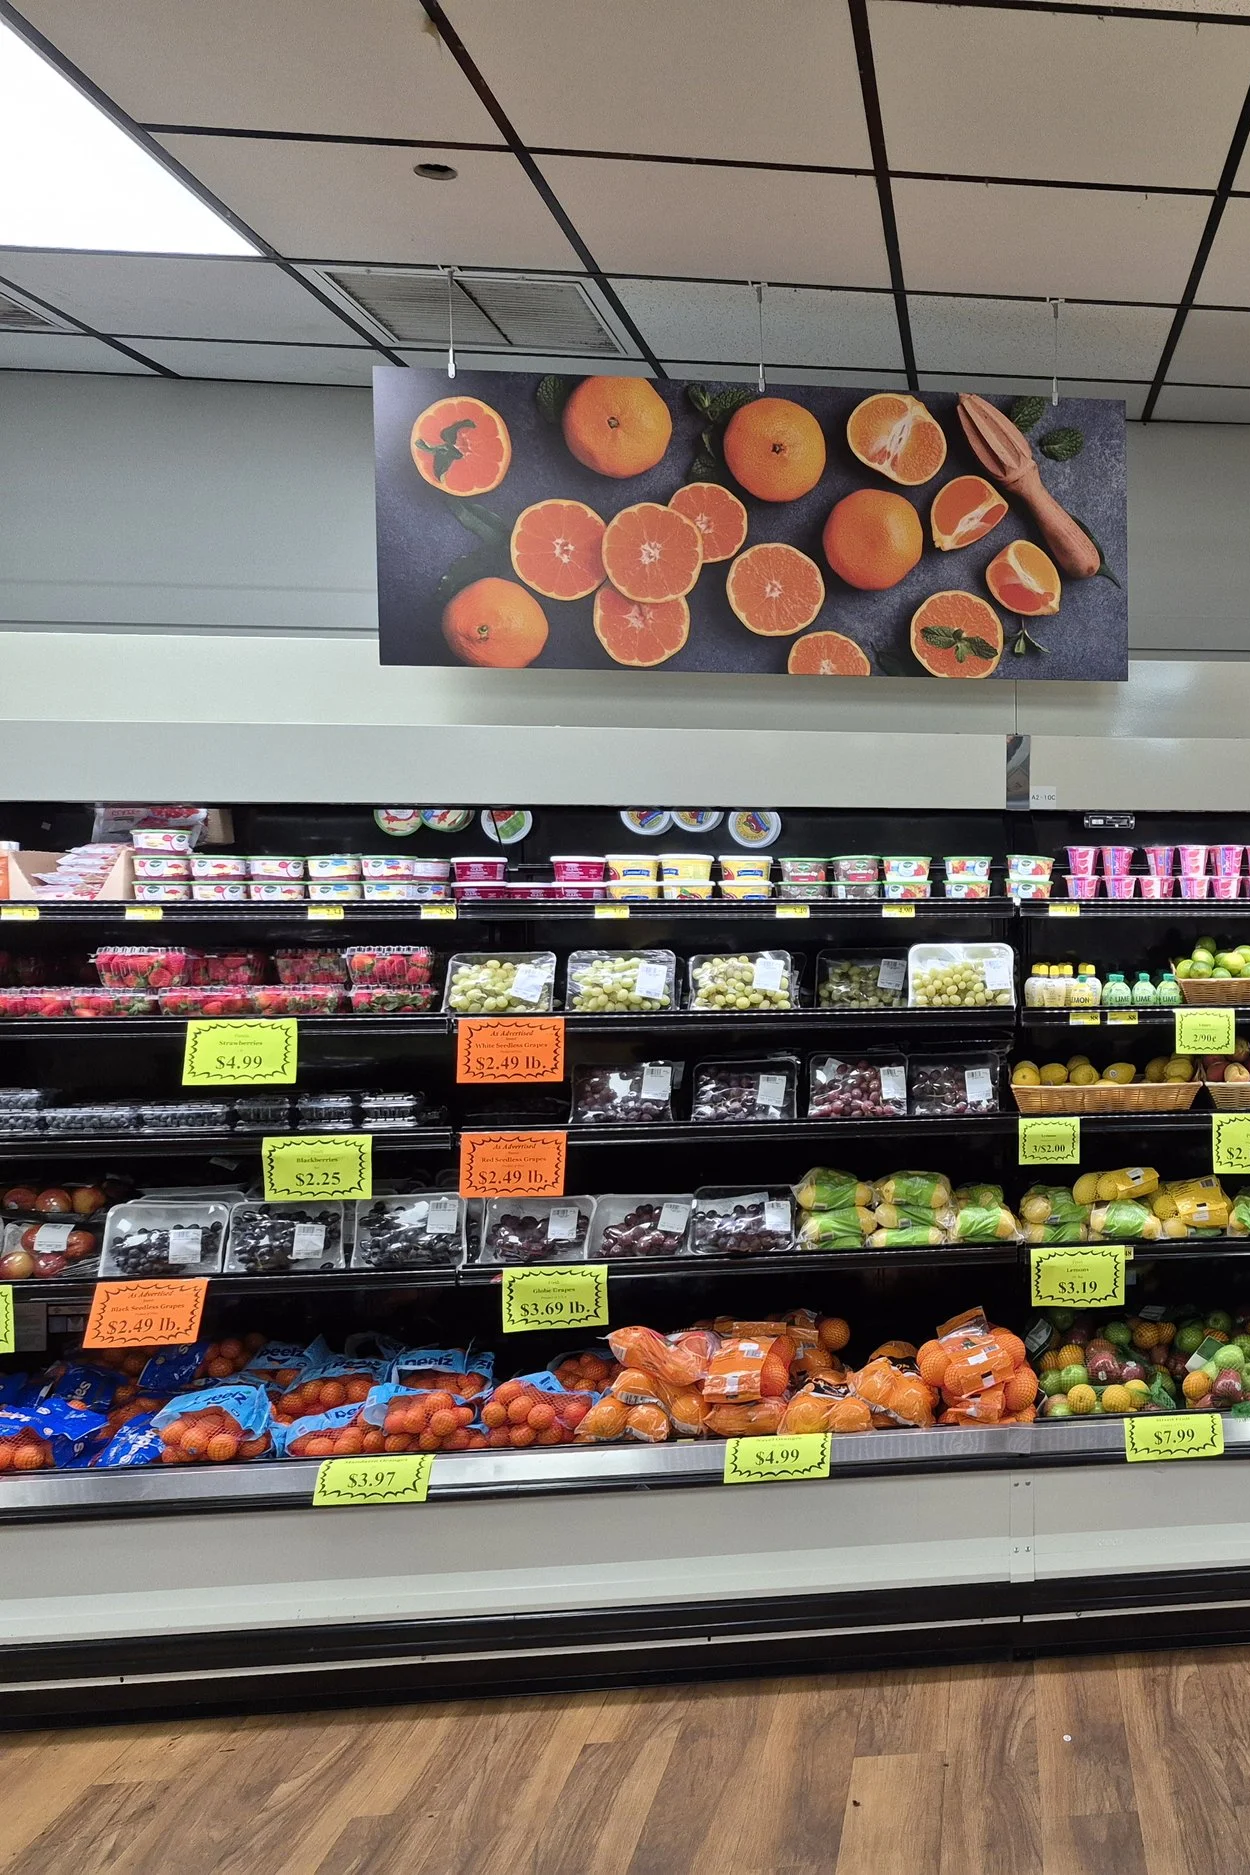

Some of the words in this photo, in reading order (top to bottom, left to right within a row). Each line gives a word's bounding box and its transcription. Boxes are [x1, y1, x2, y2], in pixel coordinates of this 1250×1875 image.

[215, 1055, 263, 1070] $4.99
[475, 1056, 520, 1071] $2.49
[525, 1055, 547, 1069] lb.
[1032, 1144, 1066, 1153] 3/$2.00
[295, 1172, 341, 1187] $2.25
[478, 1170, 522, 1185] $2.49
[528, 1170, 548, 1183] lb.
[138, 1290, 175, 1299] Advertised
[1058, 1281, 1097, 1294] $3.19
[131, 1304, 159, 1312] Seedless
[520, 1301, 564, 1317] $3.69
[569, 1301, 590, 1314] lb.
[107, 1317, 153, 1335] $2.49
[160, 1317, 180, 1331] lb.
[1154, 1429, 1195, 1445] $7.99
[755, 1449, 800, 1466] $4.99
[347, 1471, 396, 1488] $3.97
